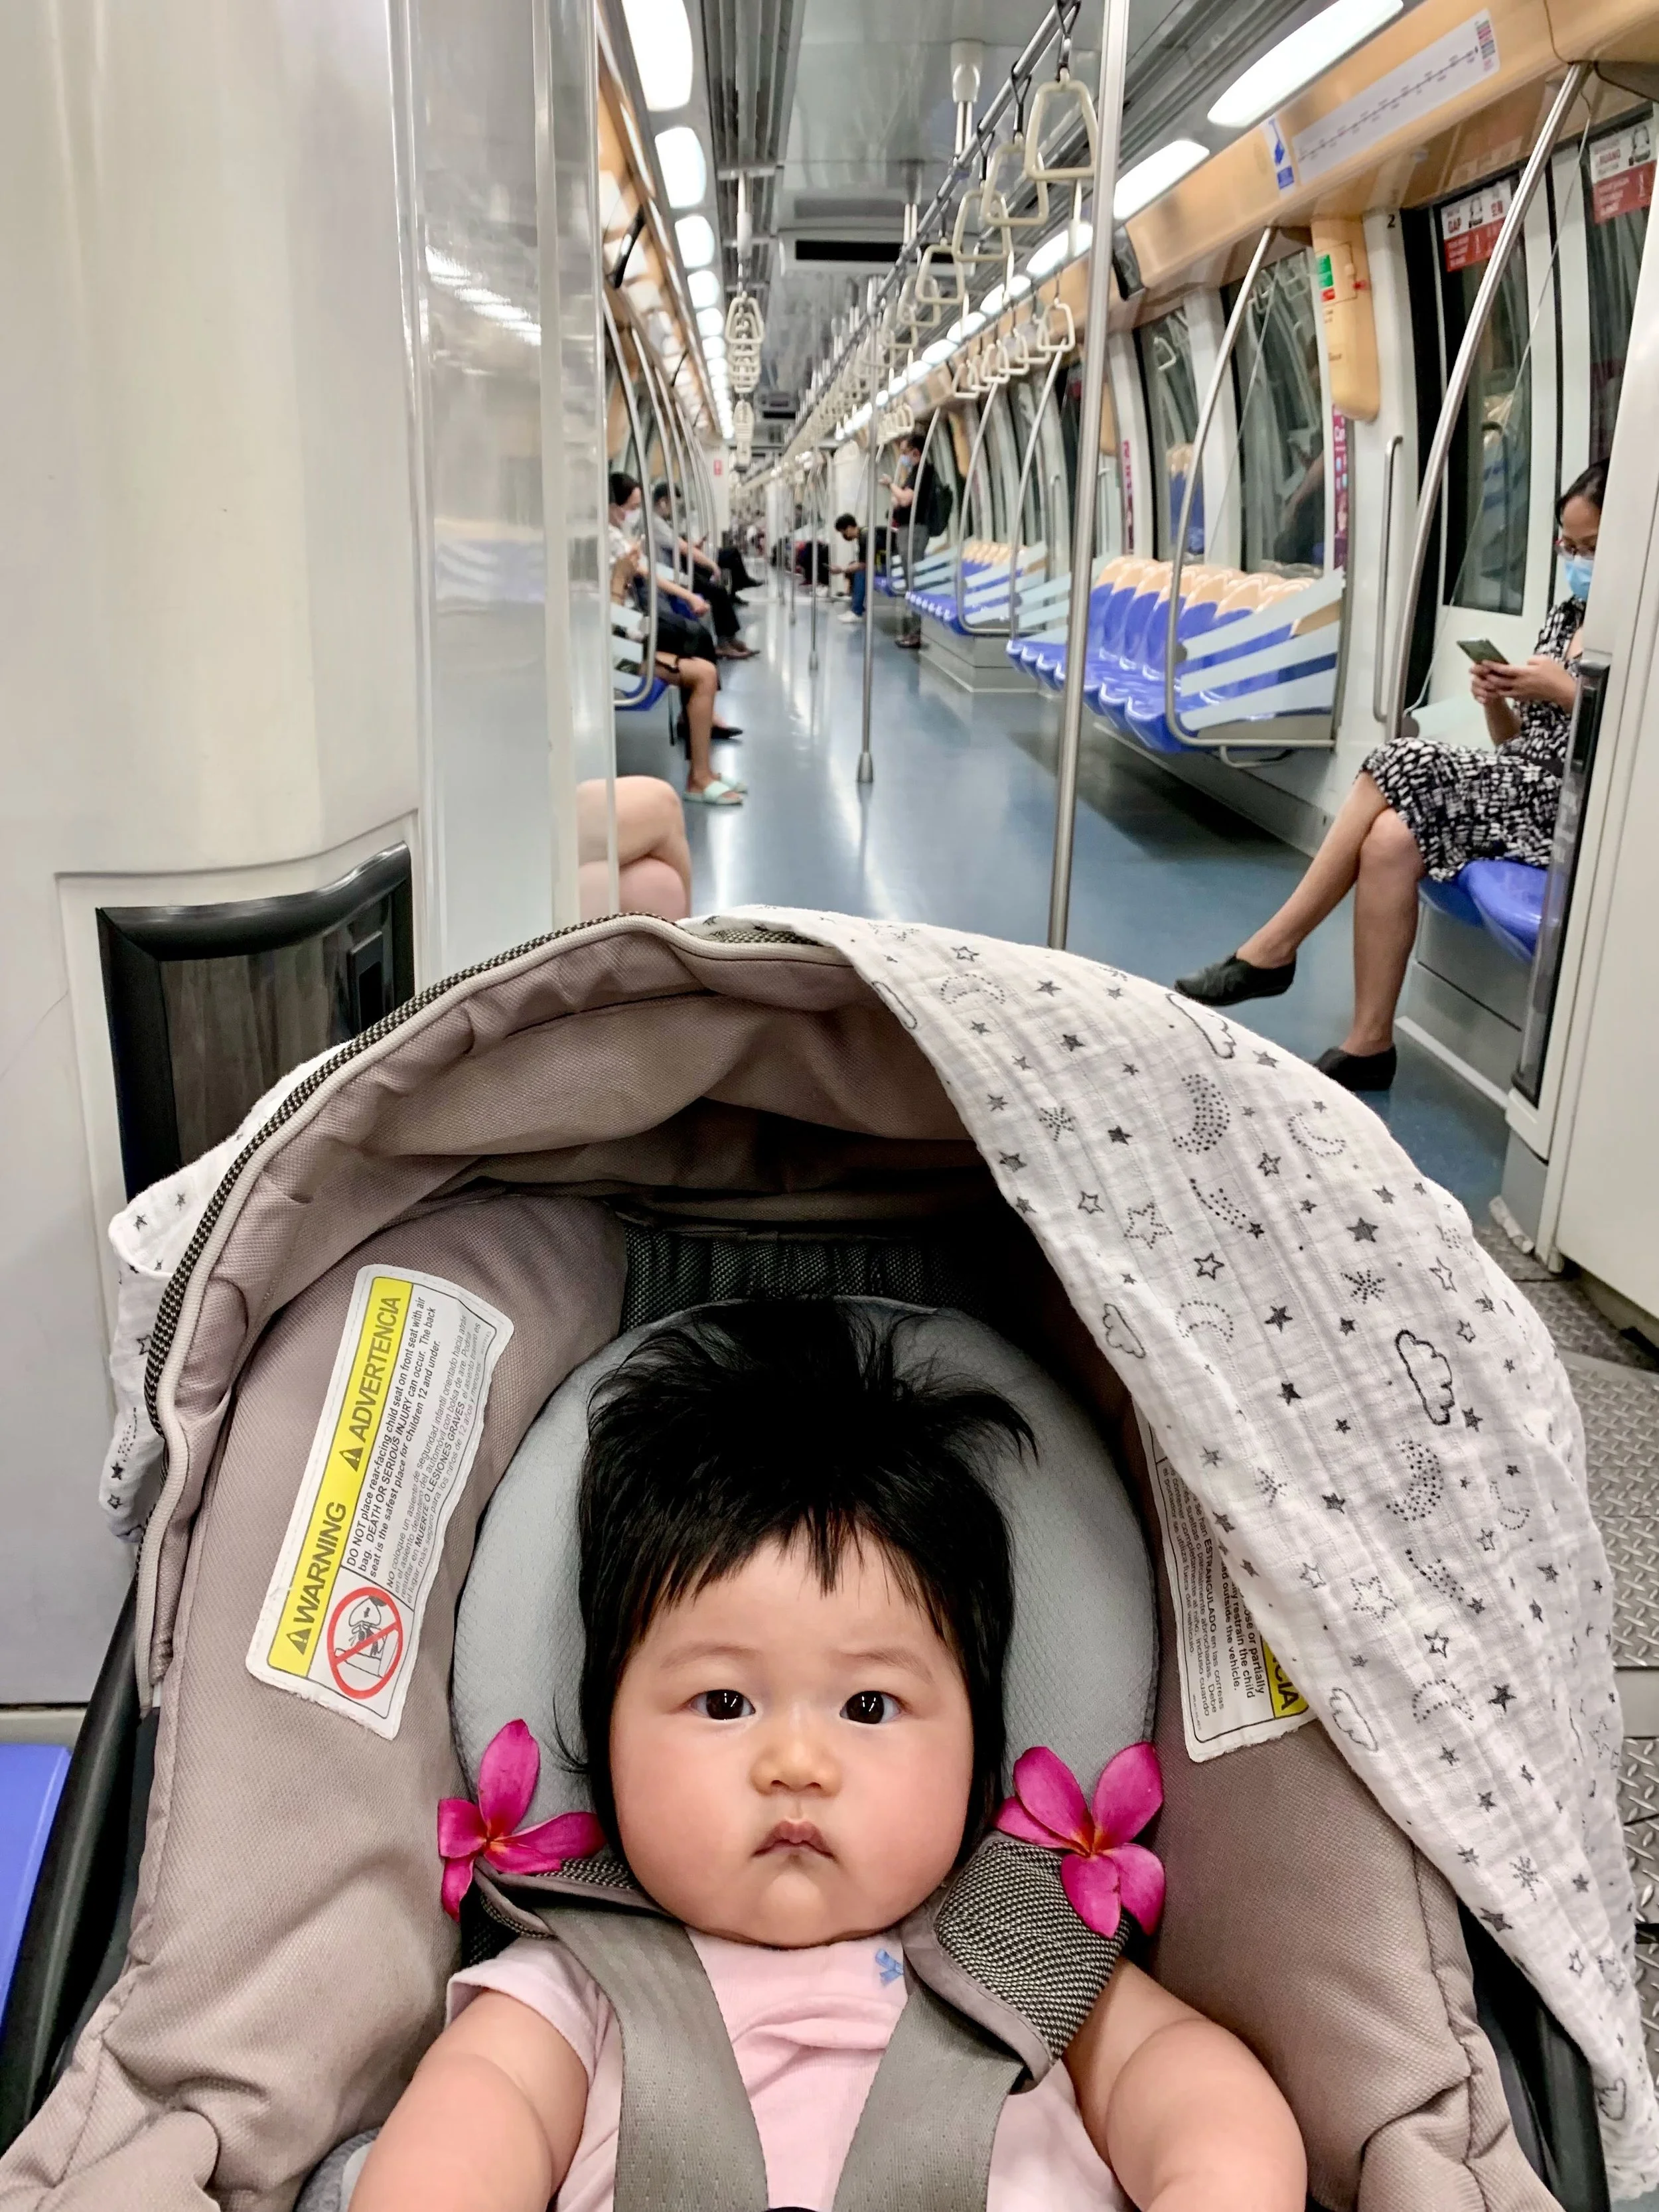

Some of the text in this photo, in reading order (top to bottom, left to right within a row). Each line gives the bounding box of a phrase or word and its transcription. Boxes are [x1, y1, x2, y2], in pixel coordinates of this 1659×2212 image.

[1387, 214, 1396, 229] 2
[474, 1323, 480, 1333] es
[428, 1341, 440, 1368] under.
[348, 1297, 400, 1443] ADVERTENCIA
[423, 1368, 433, 1387] and
[464, 1360, 474, 1390] asiento
[418, 1388, 427, 1399] 12
[455, 1376, 463, 1388] de
[447, 1389, 459, 1412] bolsa
[461, 1390, 468, 1399] el
[346, 1297, 425, 1566] DO NOT place rear-facing child seat on front seat with air
[405, 1402, 423, 1441] children
[443, 1414, 452, 1430] con
[458, 1426, 466, 1436] 12
[358, 1307, 435, 1572] bag. DEATH OR SERIOUS INJURY can occur. The back
[455, 1439, 462, 1450] de
[387, 1571, 395, 1587] NO
[392, 1532, 405, 1570] coloque
[402, 1518, 409, 1530] un
[406, 1483, 417, 1516] asiento
[413, 1470, 419, 1482] de
[416, 1424, 439, 1469] seguridad
[435, 1396, 447, 1424] infantil
[442, 1357, 457, 1396] orientado
[452, 1335, 463, 1357] hacia
[425, 1430, 447, 1473] automóvil
[394, 1459, 405, 1488] place
[426, 1442, 452, 1492] LESIONES
[1163, 1467, 1169, 1476] el
[419, 1473, 428, 1488] del
[438, 1477, 449, 1490] los
[384, 1488, 398, 1520] safest
[424, 1493, 430, 1502] O
[431, 1492, 441, 1512] para
[1164, 1479, 1176, 1518] portador
[1195, 1503, 1202, 1514] se
[378, 1522, 388, 1540] the
[415, 1503, 428, 1547] MUERTE
[1198, 1518, 1207, 1536] han
[375, 1541, 384, 1552] is
[400, 1533, 414, 1568] asiento
[411, 1548, 419, 1561] en
[1176, 1535, 1187, 1563] utiliza
[293, 1501, 346, 1623] WARNING
[370, 1553, 380, 1577] seat
[397, 1568, 402, 1578] el
[394, 1581, 400, 1593] en
[400, 1563, 413, 1598] resultar
[409, 1570, 419, 1593] lugar
[1205, 1538, 1216, 1632] ESTRANGULADO
[407, 1594, 412, 1603] el
[1172, 1478, 1185, 1518] contener
[1181, 1522, 1196, 1596] completamente
[1193, 1599, 1198, 1608] al
[1200, 1676, 1209, 1716] cuando
[1187, 1505, 1199, 1540] sueltas
[1208, 1684, 1217, 1712] Debe
[1210, 1635, 1216, 1648] en
[1222, 1582, 1231, 1622] outside
[1228, 1647, 1240, 1690] vehicle.
[1248, 1632, 1256, 1643] or
[1233, 1602, 1244, 1645] restrain
[1242, 1670, 1255, 1698] child
[1248, 1647, 1264, 1692] partially
[1214, 1670, 1224, 1709] correas
